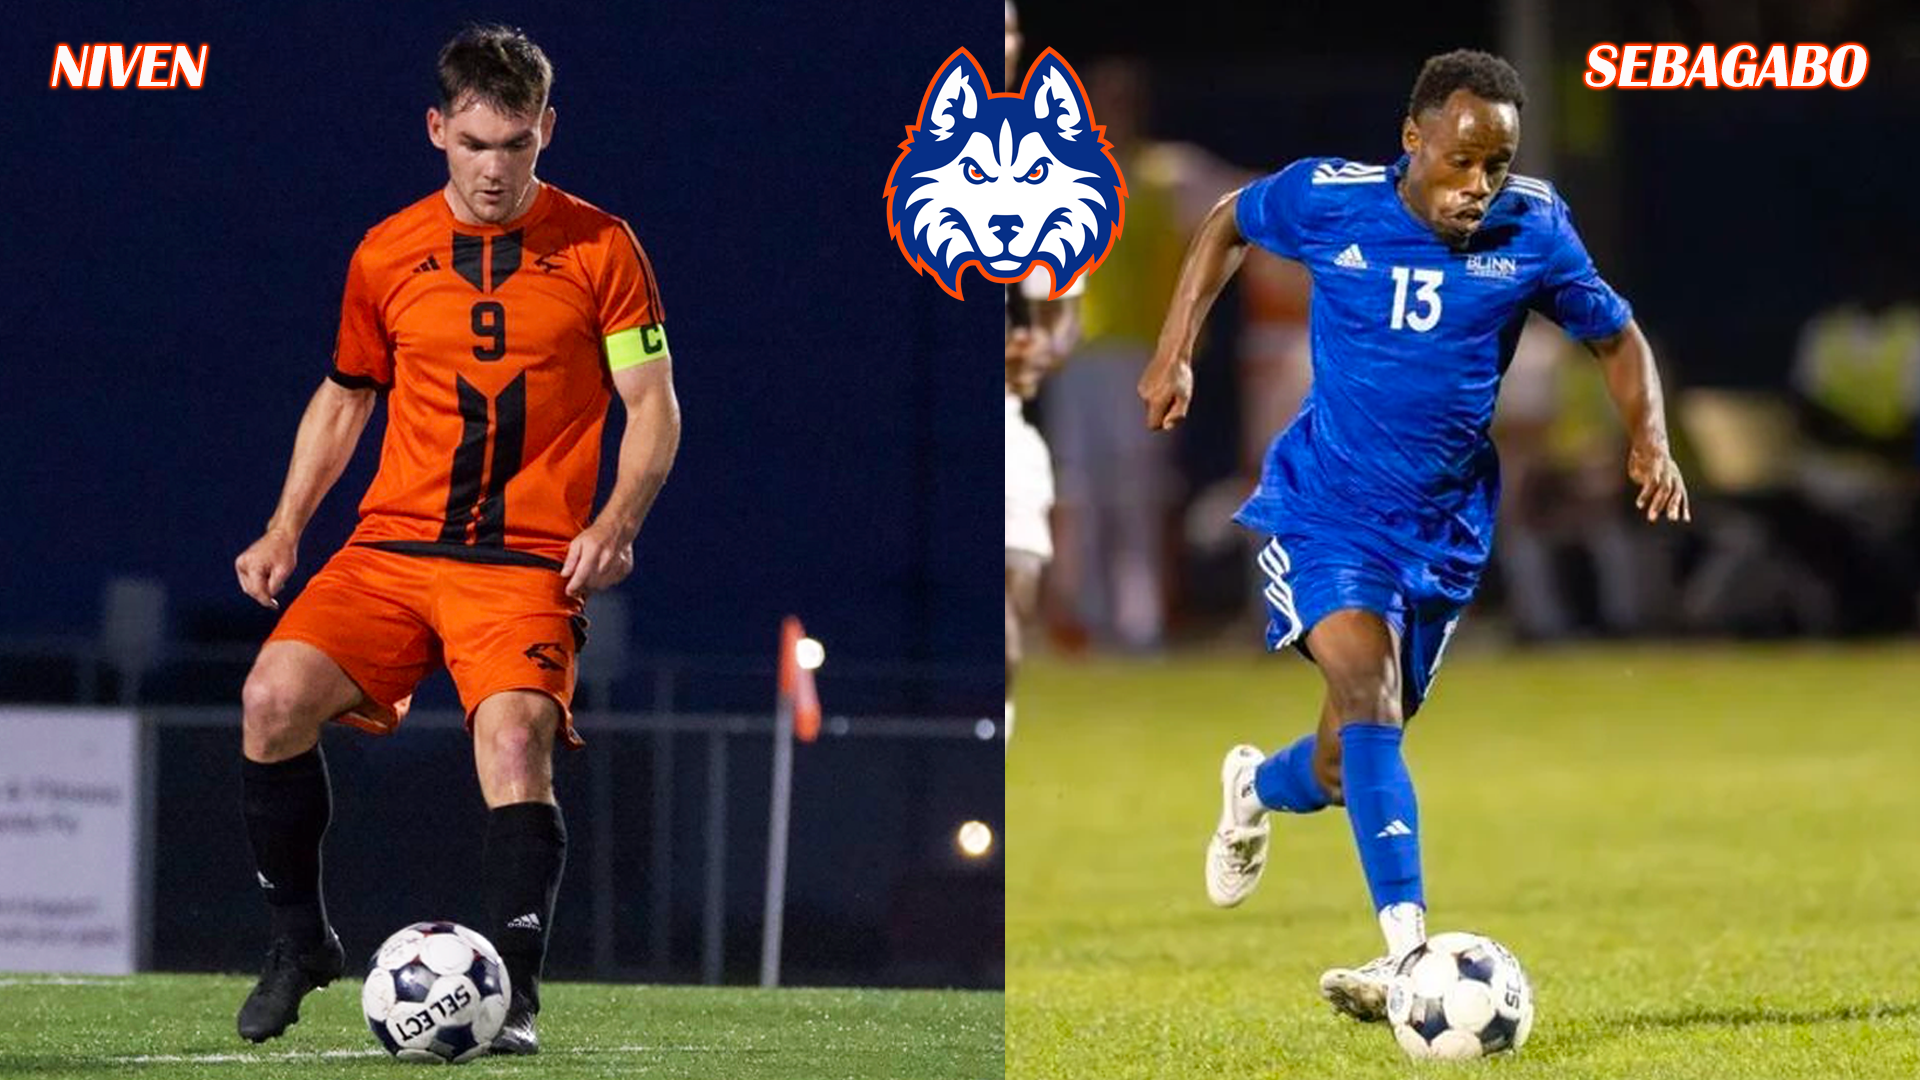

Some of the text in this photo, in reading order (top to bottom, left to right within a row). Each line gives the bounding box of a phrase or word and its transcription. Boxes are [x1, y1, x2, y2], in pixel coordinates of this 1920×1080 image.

[1466, 254, 1516, 271] BLINN
[1390, 265, 1444, 333] 13
[471, 301, 506, 362] 9
[640, 324, 663, 355] C
[396, 984, 472, 1042] SELECT
